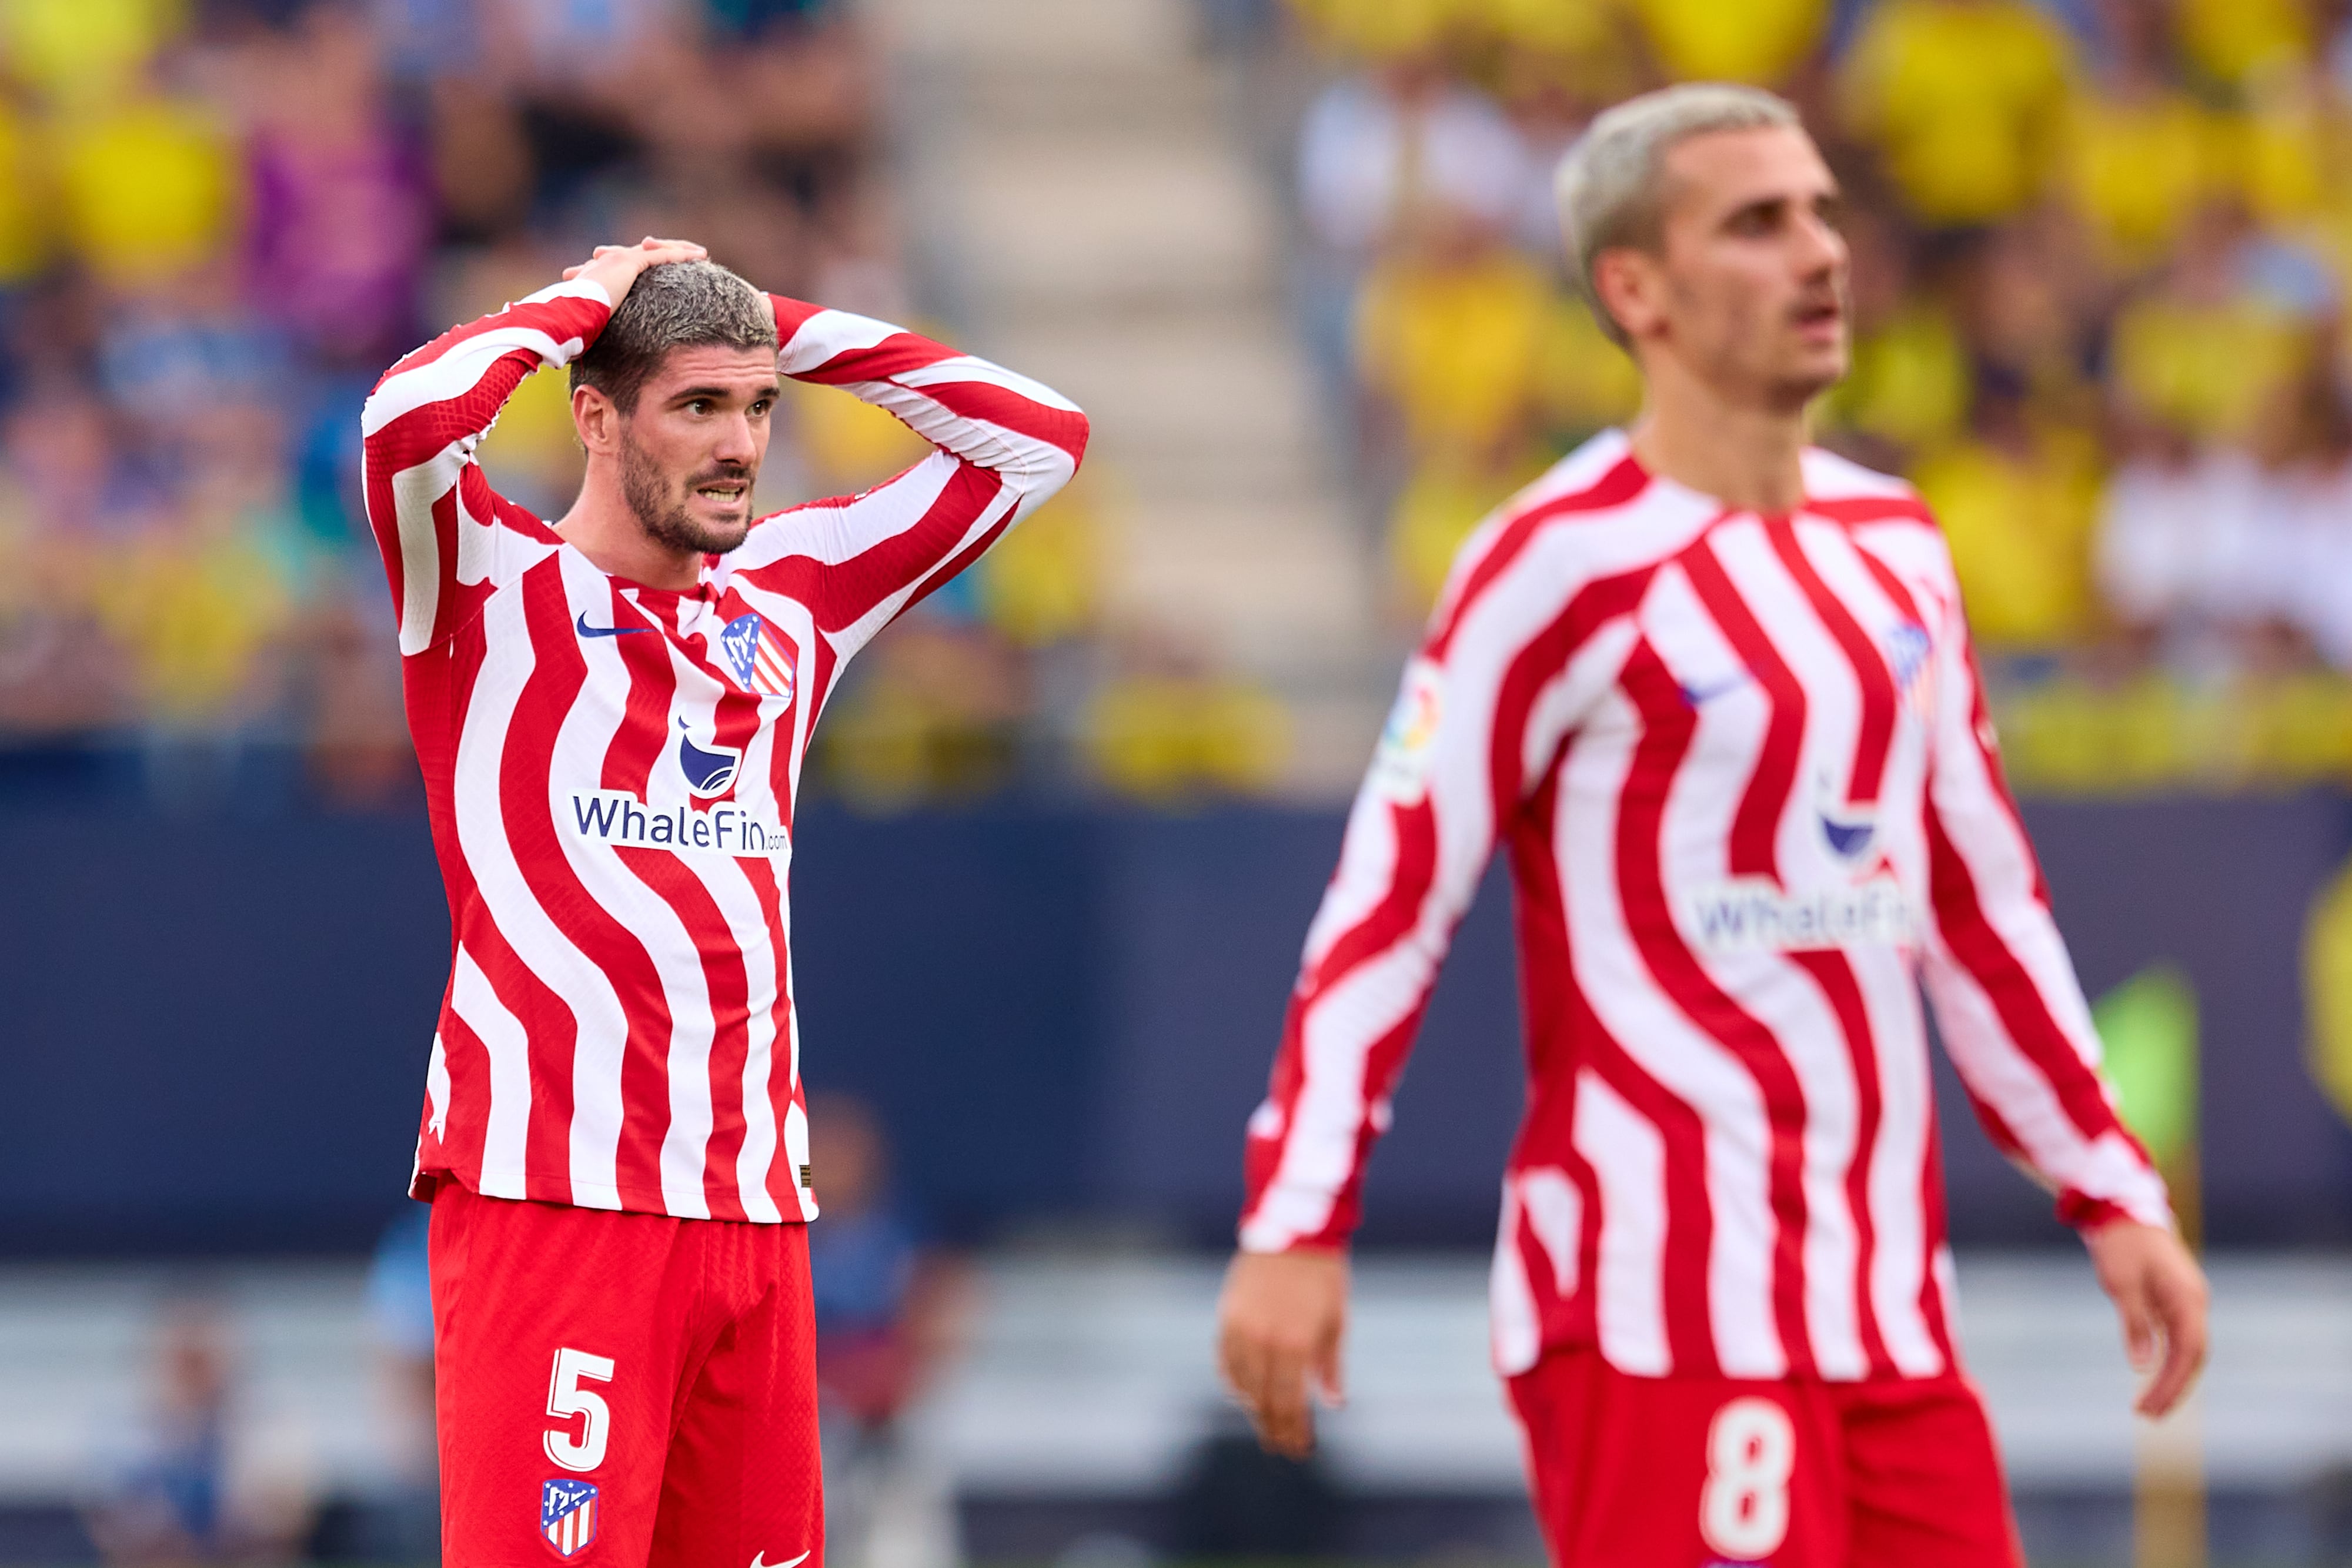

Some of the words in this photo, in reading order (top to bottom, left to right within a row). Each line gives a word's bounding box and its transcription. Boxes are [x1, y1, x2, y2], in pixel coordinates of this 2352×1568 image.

[573, 796, 787, 850] WhaleFin.com
[542, 1347, 614, 1472] 5
[1699, 1396, 1796, 1560] 8
